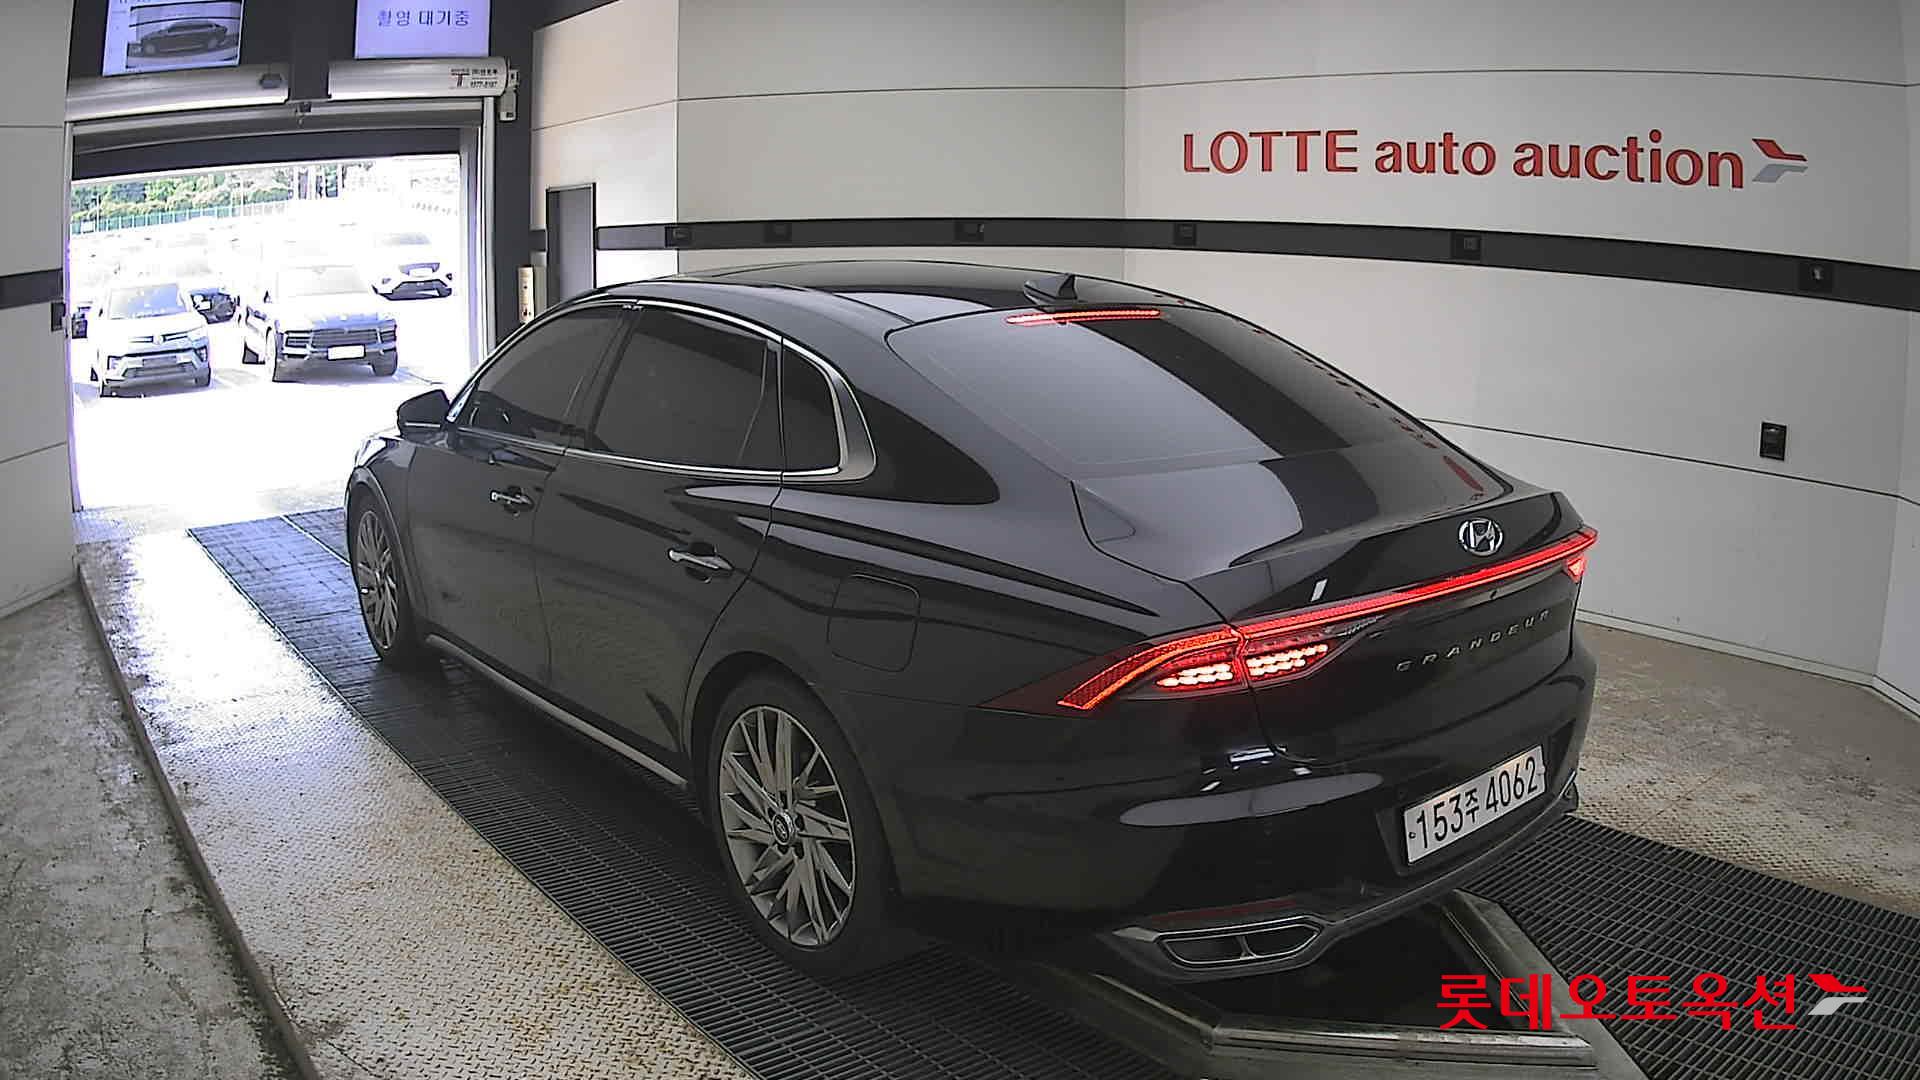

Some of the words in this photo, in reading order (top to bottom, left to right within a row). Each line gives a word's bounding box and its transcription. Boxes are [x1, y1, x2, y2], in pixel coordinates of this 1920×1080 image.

[418, 10, 470, 27] 대기중
[1183, 130, 1359, 173] LOTTE
[1374, 132, 1496, 176] auto
[1512, 130, 1744, 189] auction
[1396, 609, 1550, 672] GRANDEUR
